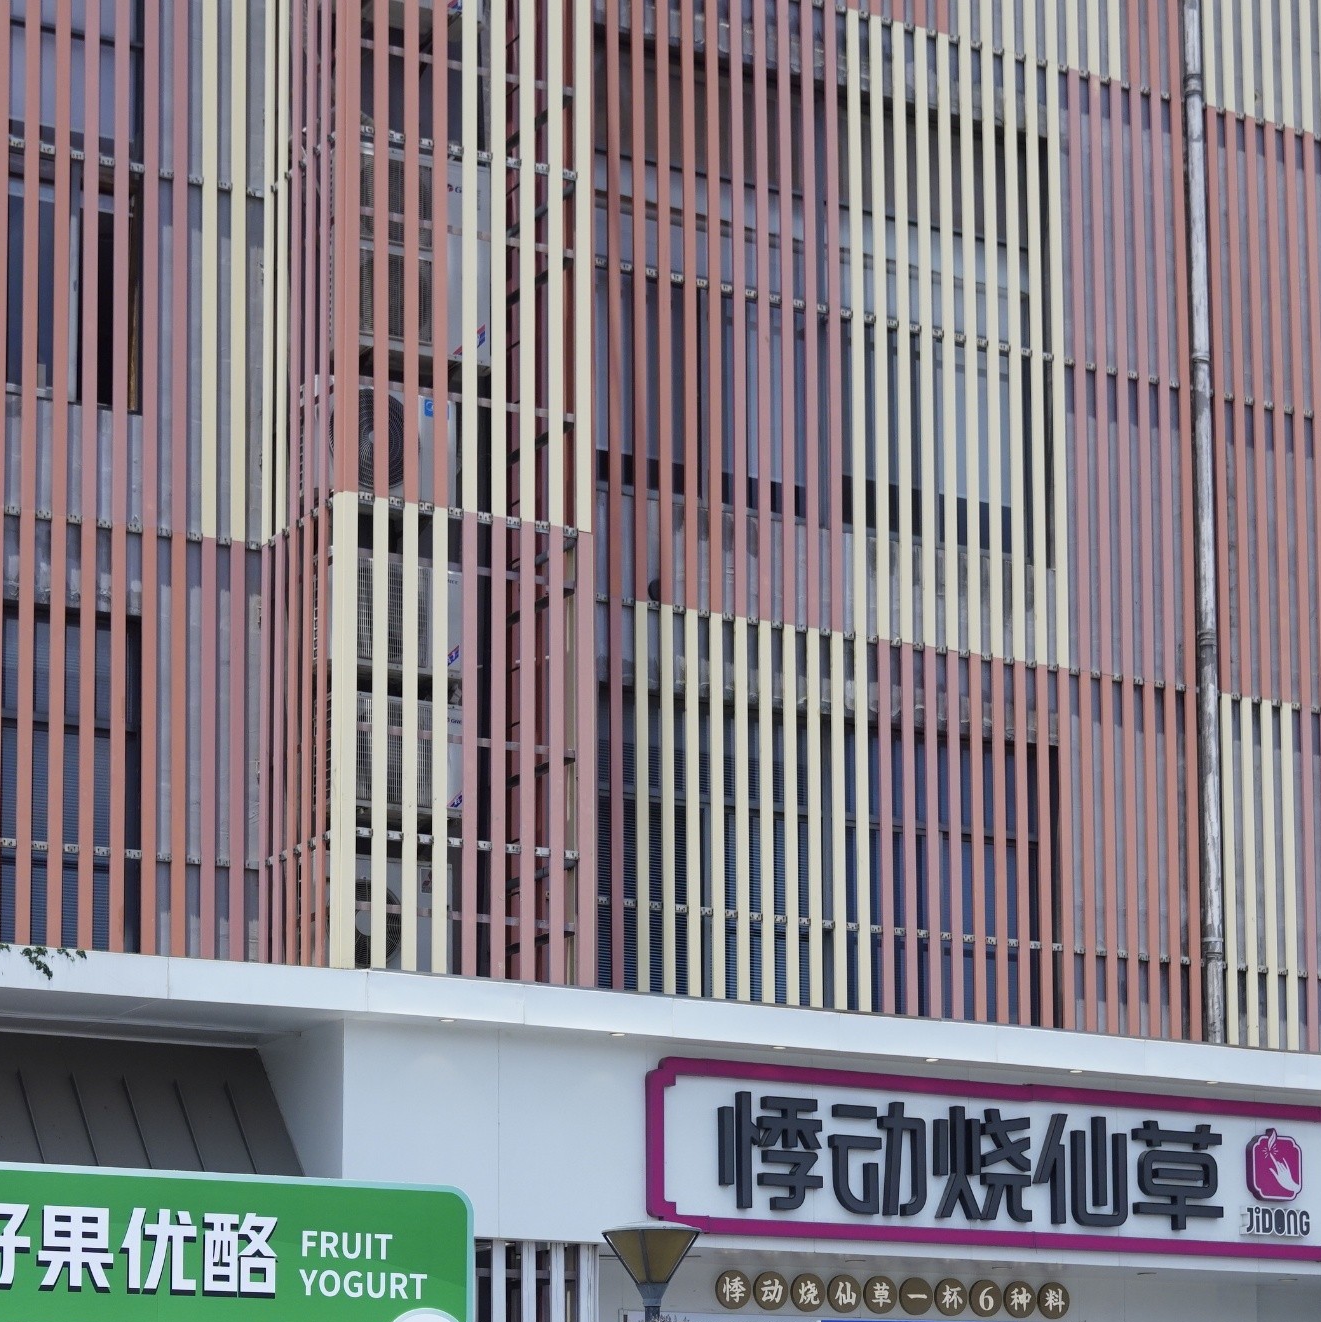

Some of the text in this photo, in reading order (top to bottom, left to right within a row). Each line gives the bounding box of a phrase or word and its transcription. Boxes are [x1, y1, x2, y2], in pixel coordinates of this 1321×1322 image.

[716, 1091, 1224, 1231] 悸动烧仙草
[300, 1229, 393, 1261] FRUIT
[299, 1269, 428, 1300] YOGURT
[721, 1275, 1067, 1315] 悸动烧仙草一杯6种料
